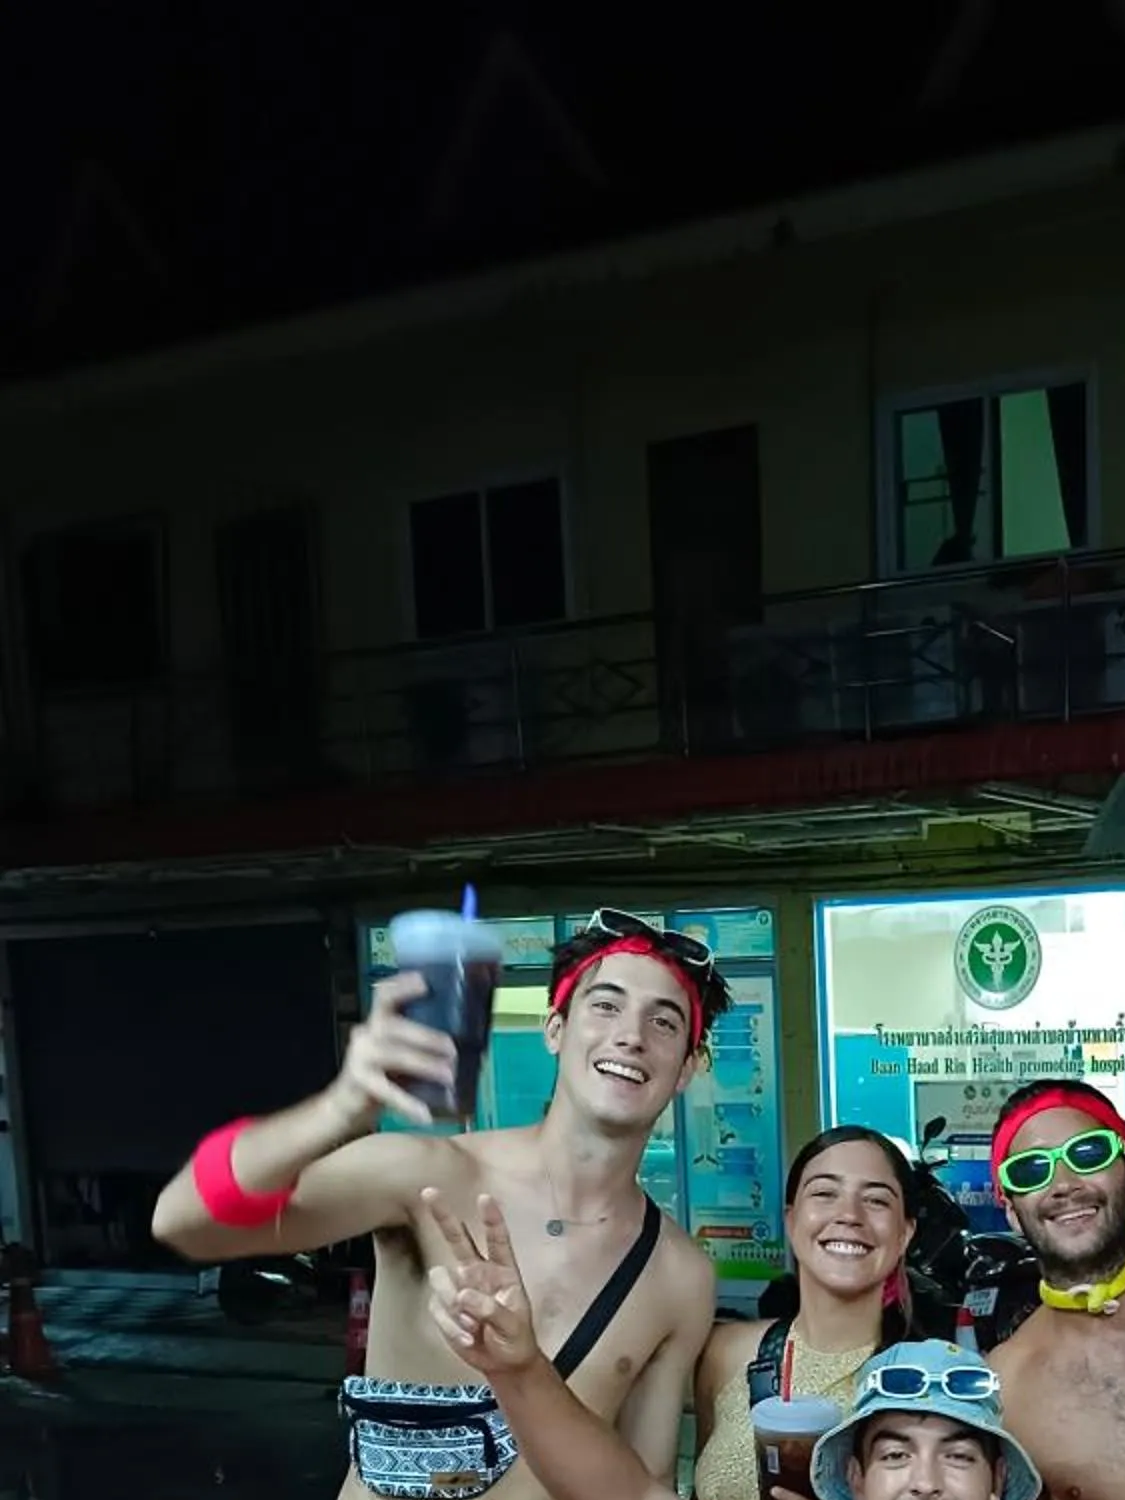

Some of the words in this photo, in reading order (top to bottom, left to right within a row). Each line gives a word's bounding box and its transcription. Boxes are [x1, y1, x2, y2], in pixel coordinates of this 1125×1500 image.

[907, 1057, 939, 1074] Haad
[944, 1057, 967, 1074] Rin
[972, 1056, 1013, 1073] Health
[1019, 1058, 1085, 1077] promoting
